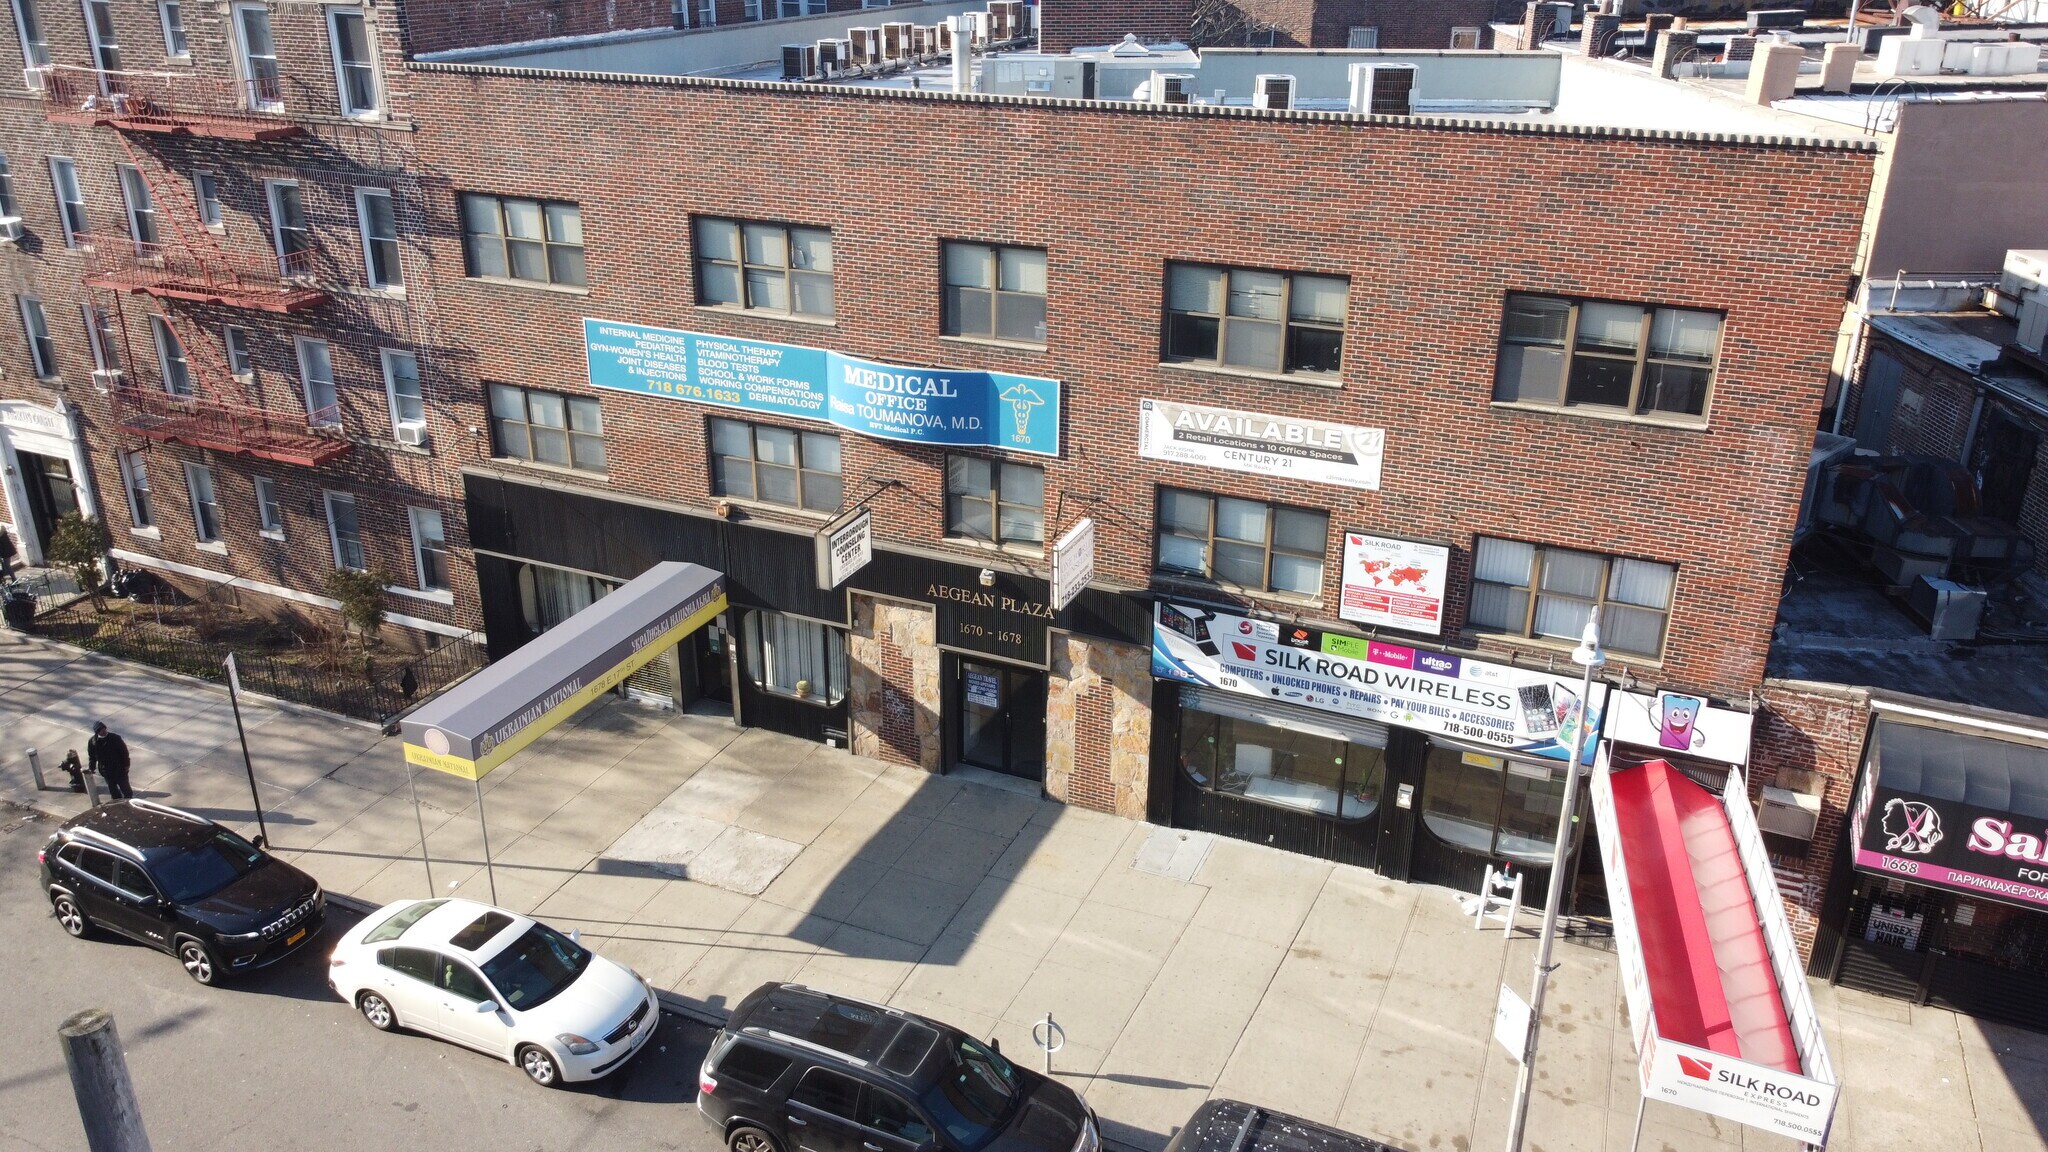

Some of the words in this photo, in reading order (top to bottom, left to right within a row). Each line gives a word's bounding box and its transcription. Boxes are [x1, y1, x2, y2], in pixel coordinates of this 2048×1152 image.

[600, 327, 641, 339] INTERNAL
[643, 333, 685, 345] MEDICINE
[591, 343, 651, 358] GYN-WOMEN'S
[653, 352, 686, 363] HEALTH
[635, 340, 685, 354] PEDIATRICS
[696, 339, 740, 352] PHYSICAL
[741, 345, 783, 358] THERAPY
[617, 356, 641, 365] JOINT
[644, 360, 686, 372] DISEASES
[696, 349, 780, 367] VITAMINOTHERAPY
[697, 358, 728, 369] BLOOD
[731, 363, 759, 373] TESTS
[637, 367, 687, 381] INJECTIONS
[698, 367, 736, 380] SCHOOL
[738, 373, 745, 381] &
[747, 374, 775, 385] WORK
[777, 378, 809, 390] FORMS
[843, 364, 957, 397] MEDICAL
[647, 379, 672, 392] 718
[676, 383, 740, 402] 676.1633
[699, 376, 742, 389] WORKING
[744, 382, 824, 401] COMPENSATIONS
[749, 392, 821, 409] DERMATOLOGY
[865, 391, 926, 411] OFFICE
[830, 395, 855, 415] Raisa
[857, 404, 947, 430] TOUMANOVA,
[952, 416, 982, 430] M.D.
[883, 424, 909, 434] Medical
[911, 428, 924, 436] P.C.
[1174, 409, 1343, 449] AVAILABLE
[1011, 434, 1031, 444] 1670
[1186, 433, 1212, 442] Retail
[1214, 438, 1257, 449] Locations
[1267, 444, 1277, 452] 10
[1279, 446, 1307, 456] Office
[1309, 450, 1343, 461] Spaces
[1223, 450, 1279, 466] CENTURY
[1282, 459, 1292, 467] 21
[831, 517, 868, 550] INTERBOROUGH
[836, 530, 865, 557] COUNSELING
[1381, 542, 1401, 550] ROAD
[841, 543, 861, 564] CENTER
[926, 584, 995, 609] AEGEAN
[1001, 597, 1055, 620] PLAZA
[631, 618, 669, 652] УКРАЇНСЬКА
[959, 622, 983, 637] 1670
[998, 630, 1022, 645] 1678
[1331, 638, 1359, 649] SIMPLE
[590, 681, 605, 696] 1678
[1219, 677, 1238, 688] 1670
[1264, 649, 1314, 672] SILK
[1316, 659, 1379, 685] ROAD
[1384, 672, 1511, 710] WIRELESS
[1219, 662, 1264, 682] COMPUTERS
[1271, 673, 1310, 690] UNLOCKED
[1311, 681, 1341, 697] PHONES
[1349, 689, 1381, 705] REPAIRS
[1390, 697, 1405, 711] PAY
[1406, 700, 1427, 715] YOUR
[1428, 705, 1450, 719] BILLS
[1459, 711, 1515, 732] ACCESSORIES
[495, 702, 546, 744] UKRAINIAN
[544, 677, 583, 713] NATIONAL
[1367, 707, 1387, 715] SONY
[1443, 720, 1515, 745] 718-500-0555
[412, 752, 441, 766] UKRAINIAN
[442, 761, 470, 773] NATIONAL
[1881, 856, 1919, 874] 1668
[1873, 920, 1913, 937] UNISEX
[1661, 1087, 1677, 1096] 1670
[1717, 1070, 1760, 1091] SILK
[1763, 1082, 1820, 1107] ROAD
[1744, 1091, 1788, 1108] EXPRESS
[1750, 1100, 1783, 1113] INTERNATIONAL
[1784, 1109, 1810, 1119] SHIPMENTS
[1773, 1118, 1822, 1136] 718.500.0555
